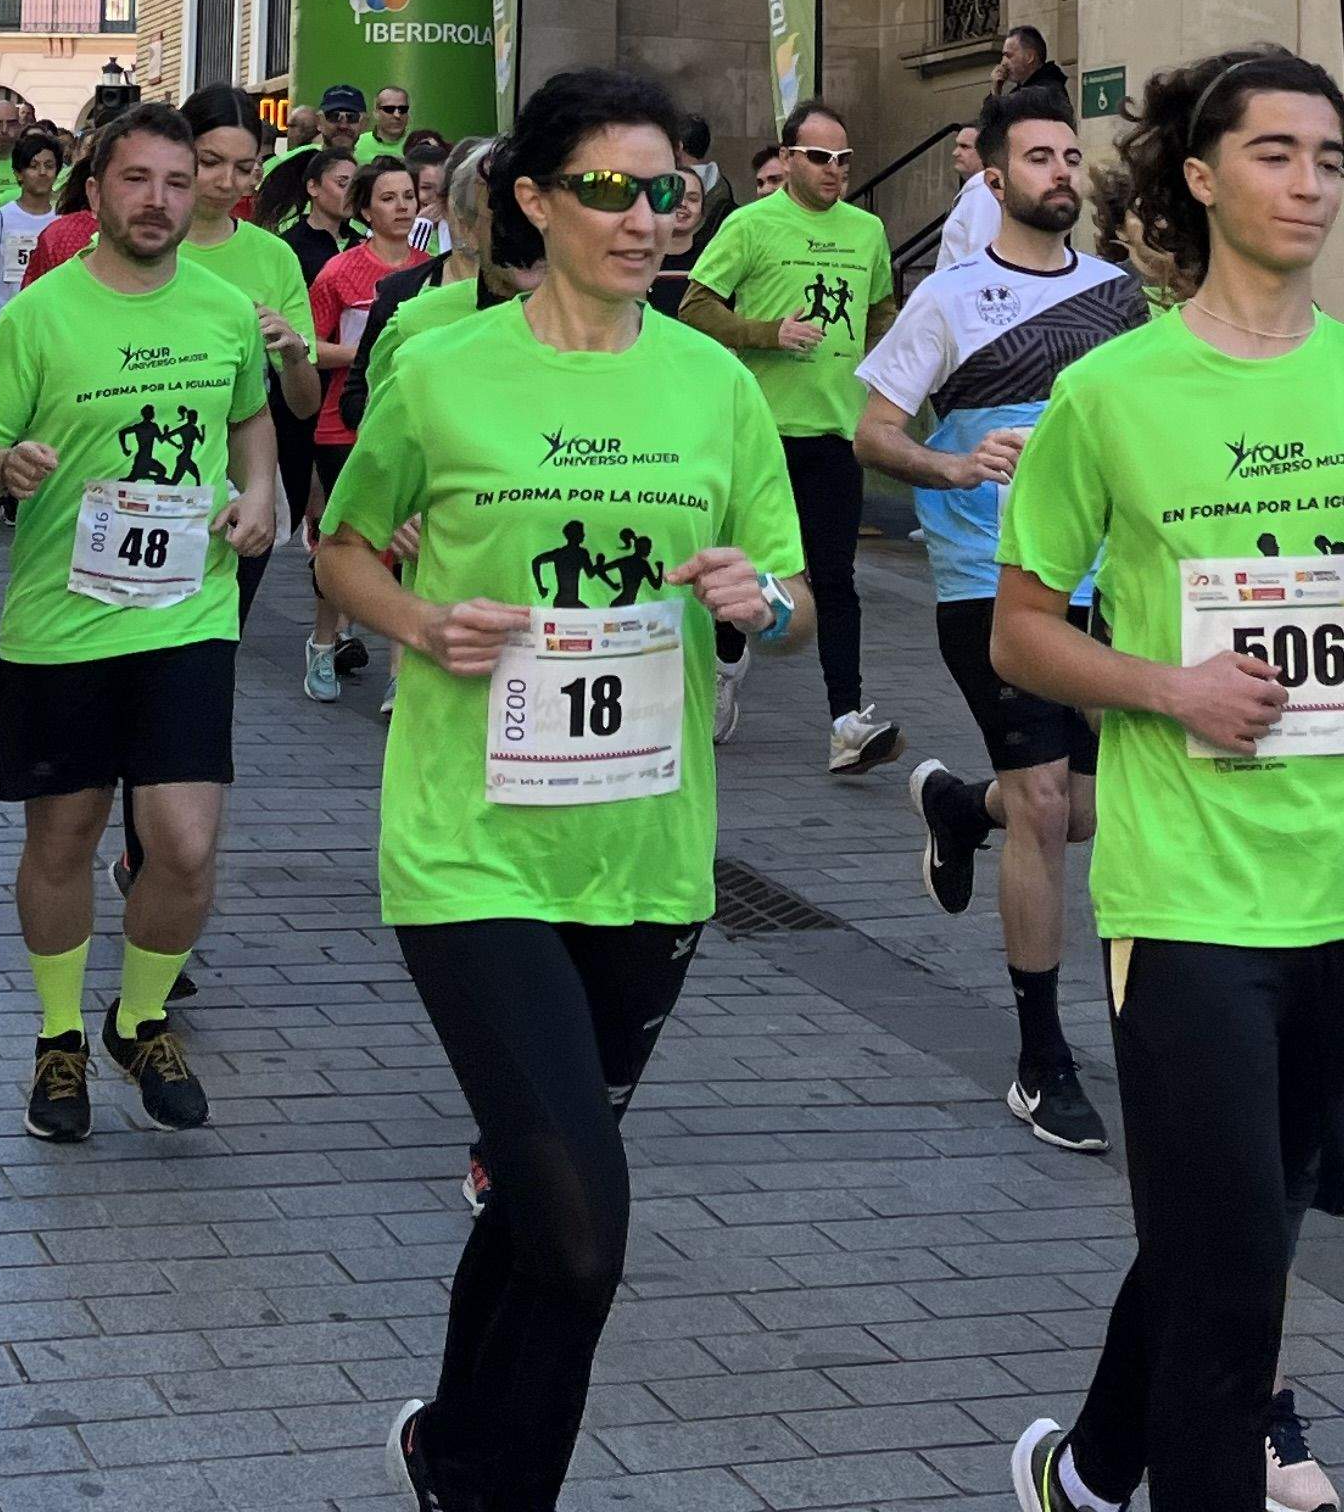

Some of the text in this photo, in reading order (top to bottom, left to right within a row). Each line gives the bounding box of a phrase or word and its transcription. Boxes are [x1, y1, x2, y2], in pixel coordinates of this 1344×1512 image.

[364, 22, 494, 46] IBERDROLA
[77, 392, 92, 403] EN
[96, 386, 138, 399] FORMA
[141, 383, 164, 393] POR
[168, 381, 183, 390] LA
[553, 452, 680, 468] UNIVERSO MUJER
[1239, 458, 1313, 479] UNIVERSO
[475, 491, 494, 506] EN
[498, 488, 562, 504] FORMA
[567, 489, 605, 502] POR
[609, 490, 631, 503] LA
[1162, 508, 1185, 524] EN
[1190, 501, 1252, 520] FORMA
[1257, 499, 1291, 514] POR
[1297, 496, 1319, 511] LA
[117, 526, 170, 569] 48
[505, 678, 527, 742] 0020
[560, 674, 623, 738] 18
